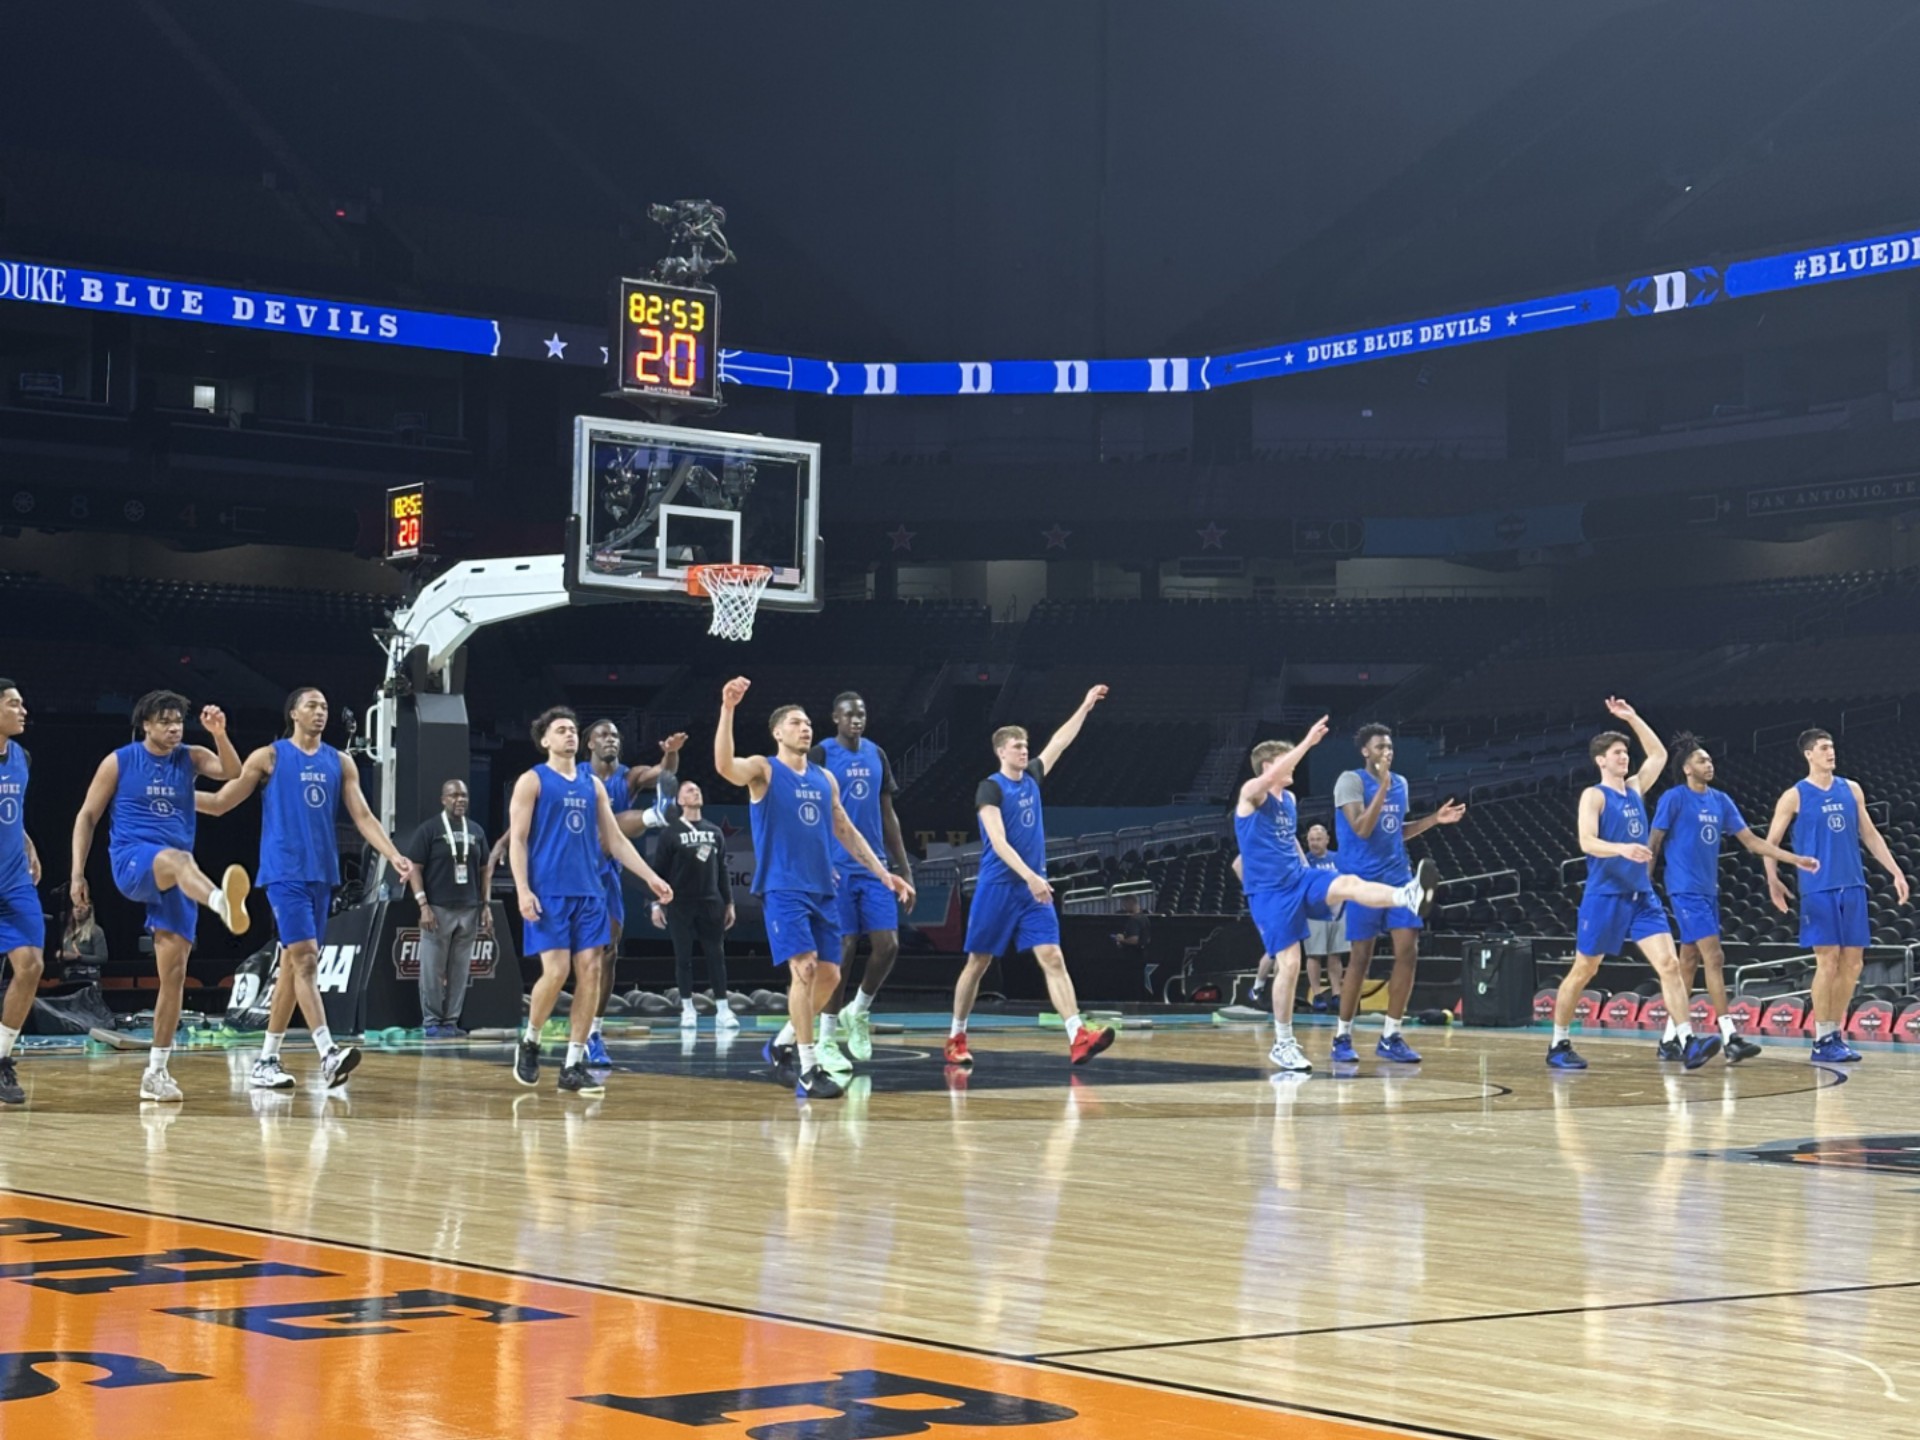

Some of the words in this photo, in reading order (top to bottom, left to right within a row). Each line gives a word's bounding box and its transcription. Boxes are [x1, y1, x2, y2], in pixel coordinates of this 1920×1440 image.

[80, 277, 204, 316] BLUE
[232, 295, 399, 338] DEVILS
[628, 292, 705, 332] 82:53
[1306, 338, 1358, 365] DUKE
[1363, 328, 1414, 355] BLUE
[1418, 314, 1492, 345] DEVILS
[635, 327, 697, 388] 20
[1750, 494, 1786, 510] SAN
[398, 518, 420, 547] 20
[300, 772, 327, 782] DUKE
[795, 789, 822, 800] DUKE
[679, 831, 716, 845] DUKE
